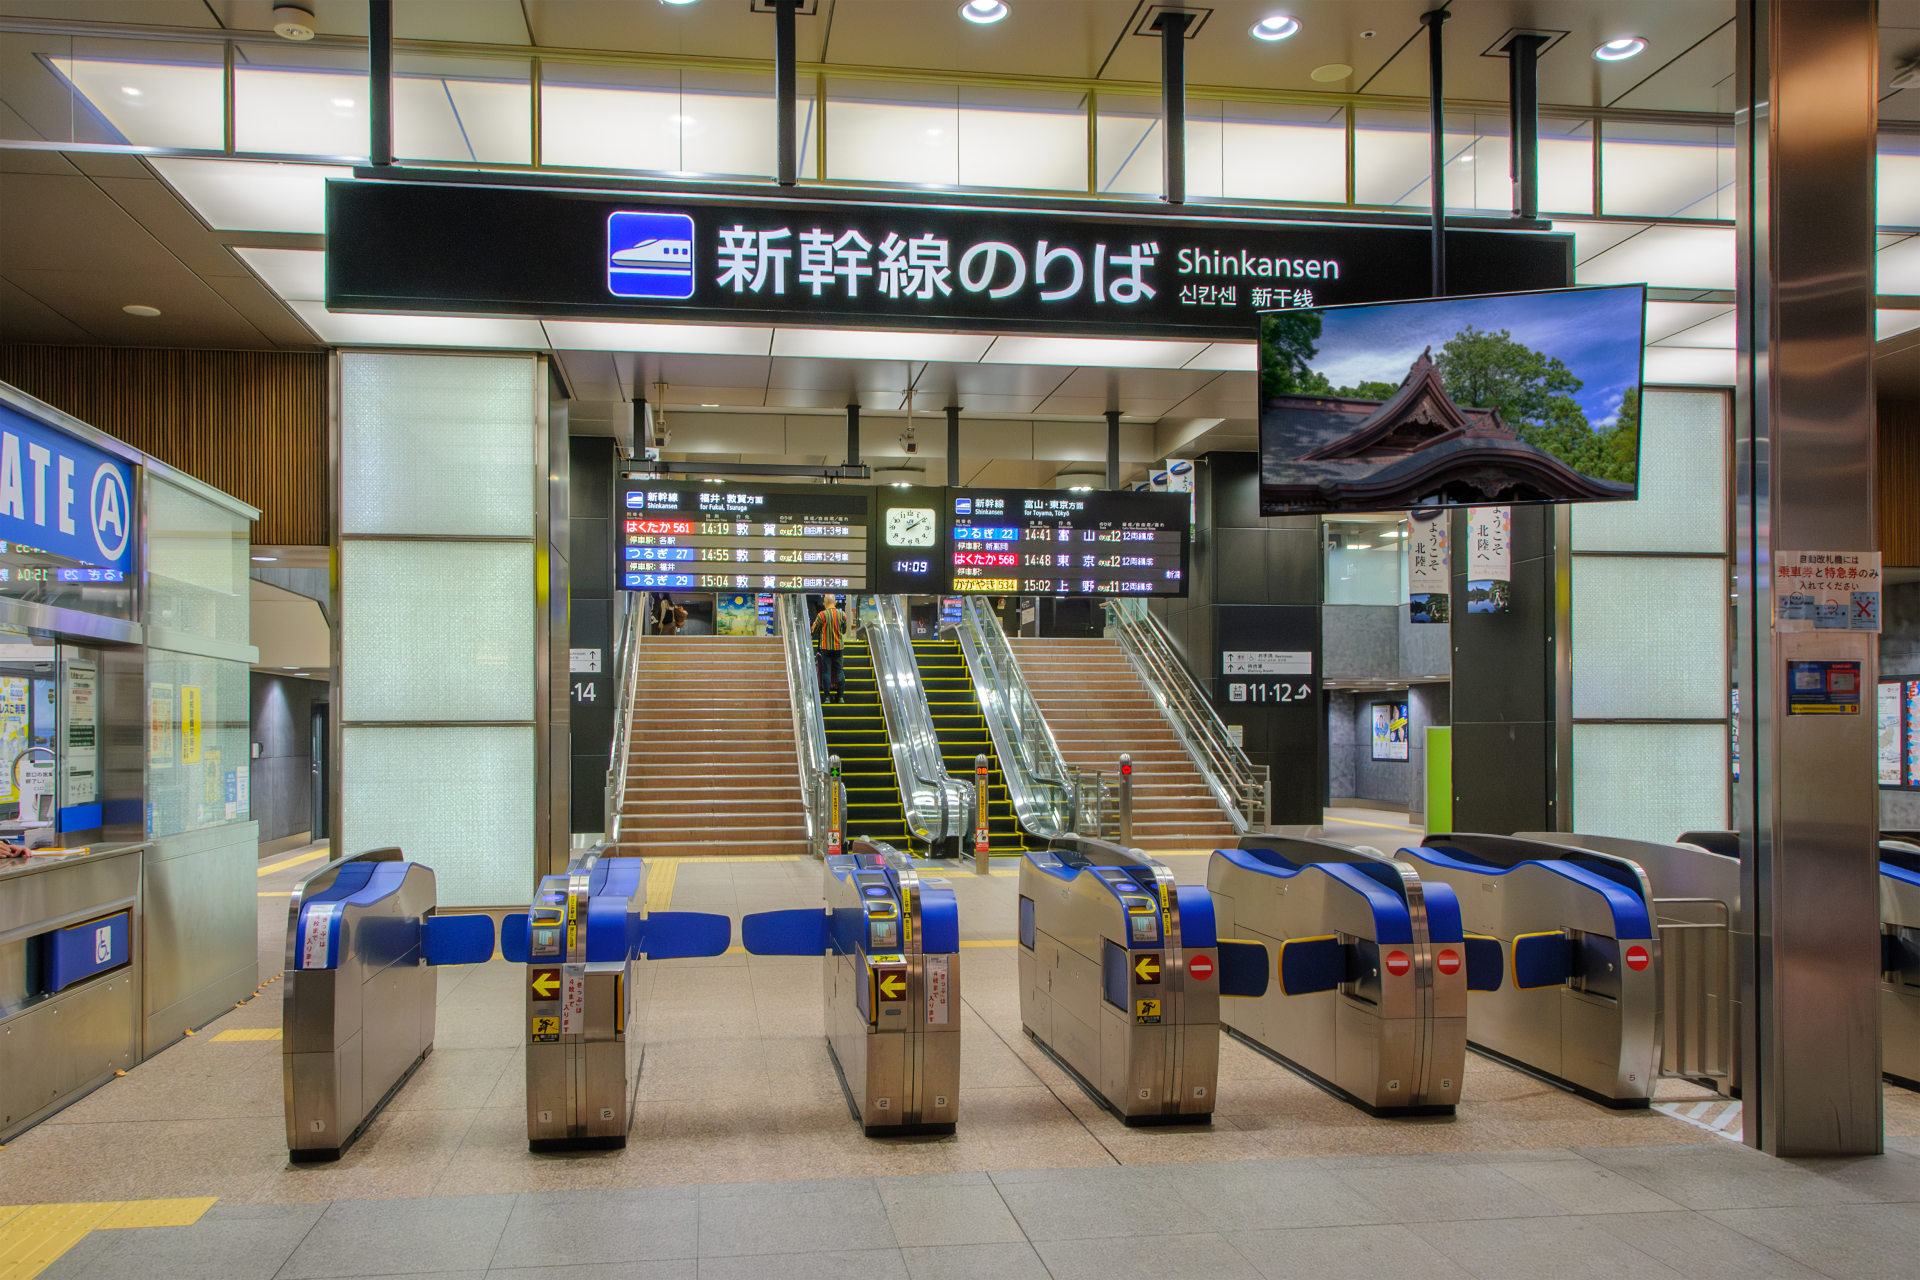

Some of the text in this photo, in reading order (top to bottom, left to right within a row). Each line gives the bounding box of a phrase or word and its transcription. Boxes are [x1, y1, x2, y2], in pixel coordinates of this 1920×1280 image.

[716, 224, 1160, 304] 新幹線のりば
[1177, 248, 1340, 280] Shinkansen
[1178, 285, 1237, 307] 신칸센
[1251, 287, 1314, 309] 新干线
[647, 491, 679, 502] 新幹線
[647, 502, 678, 510] Shinkansen
[727, 504, 748, 512] Tsuruga
[974, 498, 1005, 509] 新幹線
[974, 508, 1004, 516] Shinkansen
[1033, 510, 1054, 518] Toyama,
[626, 521, 671, 533] はくたか
[673, 523, 690, 533] 561
[701, 522, 730, 534] 14:19
[957, 528, 995, 539] つるぎ
[1001, 529, 1013, 539] 22
[1025, 528, 1051, 540] 14:41
[1428, 522, 1440, 571] ようこそ
[1477, 524, 1490, 561] 北陸へ
[628, 548, 669, 559] つるぎ
[676, 549, 688, 559] 27
[701, 549, 730, 561] 14:55
[954, 554, 997, 565] はくたか
[998, 555, 1015, 565] 568
[1024, 554, 1051, 566] 14:48
[1414, 542, 1427, 576] 北陸へ
[896, 561, 928, 573] 14:09
[1777, 565, 1879, 579] 乗車券と特急券のみ
[628, 574, 669, 586] つるぎ
[676, 575, 688, 586] 29
[701, 575, 729, 587] 15:04
[954, 579, 996, 590] かがやき
[998, 580, 1014, 590] 534
[1024, 580, 1051, 591] 15:02
[1799, 580, 1860, 591] 入れてください
[1443, 1080, 1450, 1088] 5
[1629, 1074, 1636, 1082] 5
[1141, 1090, 1148, 1098] 3
[1196, 1088, 1203, 1096] 4
[880, 1099, 888, 1108] 2
[937, 1097, 945, 1105] 3
[603, 1110, 611, 1118] 2
